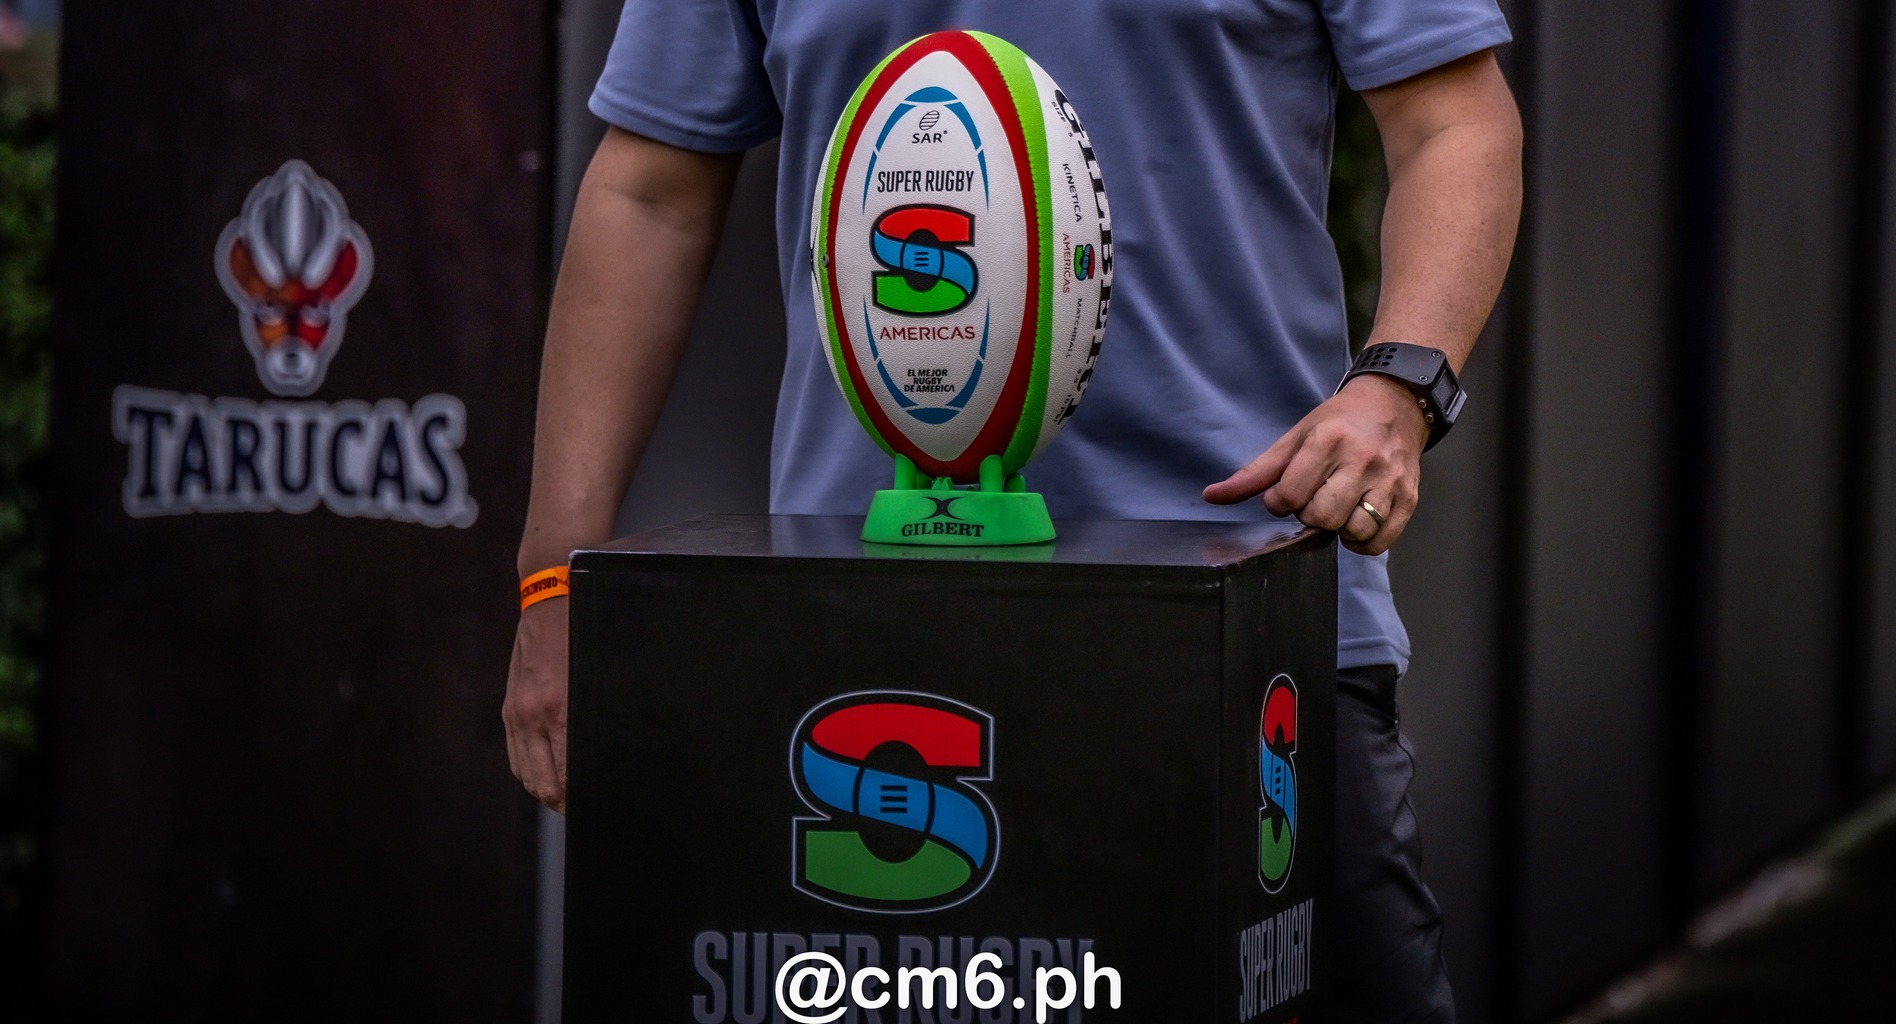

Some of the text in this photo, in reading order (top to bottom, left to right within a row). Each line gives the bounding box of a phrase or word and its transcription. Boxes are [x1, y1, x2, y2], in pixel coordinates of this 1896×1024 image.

[877, 169, 975, 193] SUPER RUGBY
[1062, 163, 1082, 222] KINETICA
[1062, 232, 1072, 294] AMERICAS
[879, 326, 976, 341] AMERICAS
[1064, 298, 1083, 359] MATCHBALL
[907, 369, 948, 377] EL MEJOR
[913, 377, 943, 385] RUGBY
[904, 385, 955, 393] DE AMERICA
[119, 396, 460, 515] TARUCAS
[901, 522, 985, 538] GILBERT
[1239, 898, 1314, 1024] SUPER RUGBY
